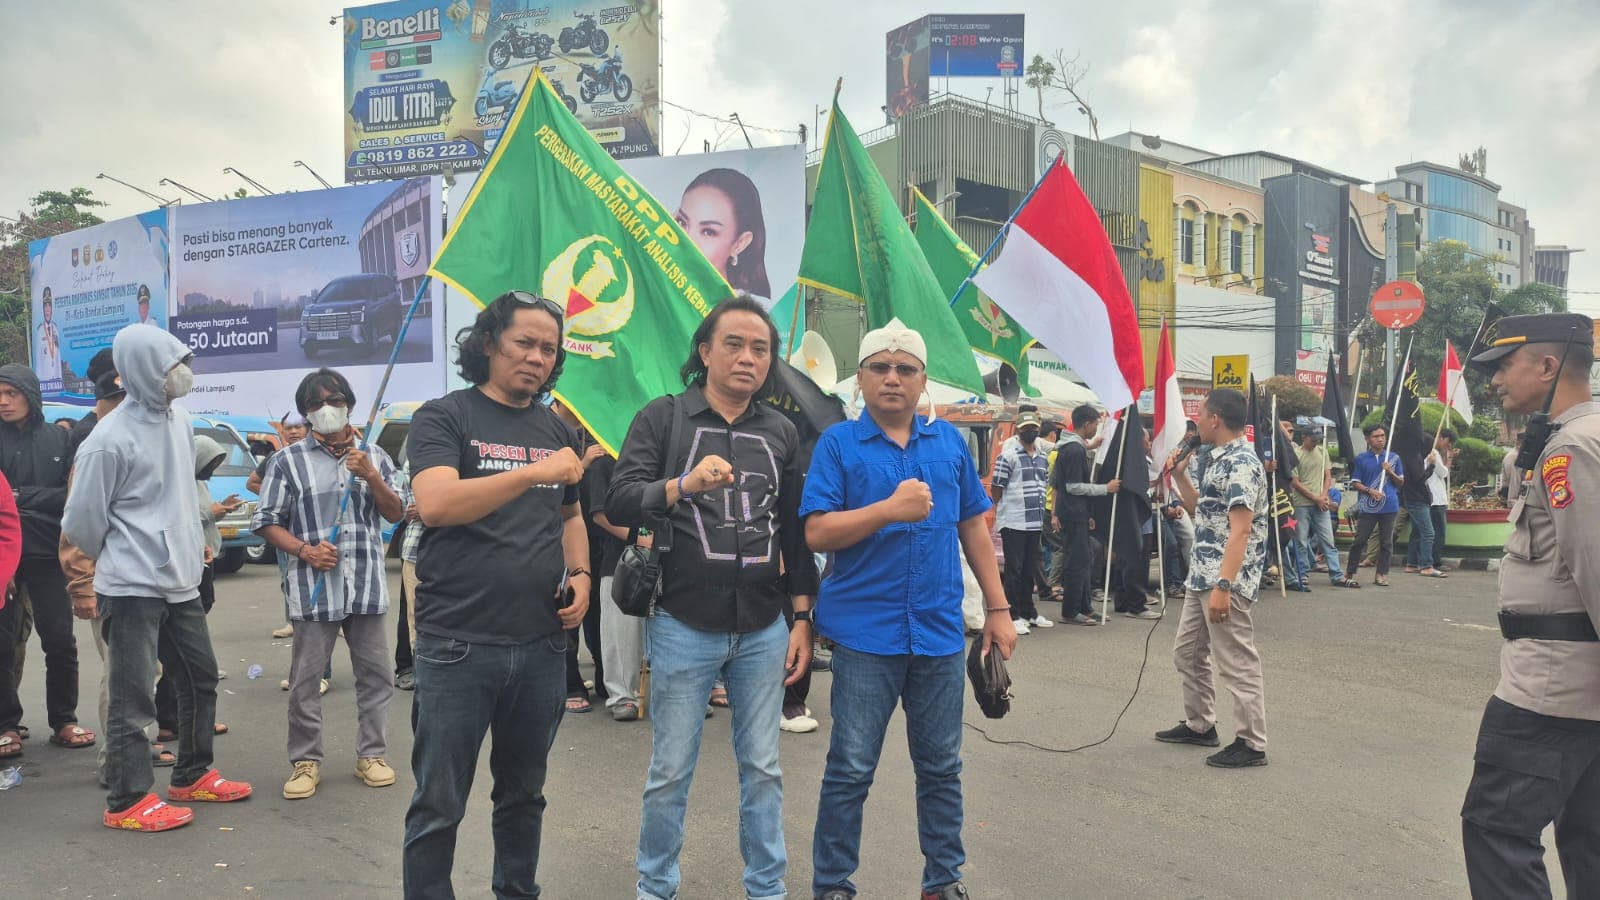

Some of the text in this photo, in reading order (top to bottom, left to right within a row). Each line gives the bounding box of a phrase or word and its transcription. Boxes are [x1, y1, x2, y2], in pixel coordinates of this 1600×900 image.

[361, 7, 441, 41] Benelli
[368, 82, 435, 97] SELAMAT HARI RAYA
[368, 90, 435, 124] IDUL FITRI
[360, 133, 445, 148] SALES & SERVICE
[368, 143, 468, 162] 0819 862 222
[534, 124, 592, 180] PERGERAKAN
[584, 172, 650, 243] MASYARAKAT
[642, 239, 688, 290] ANALISIS
[613, 175, 680, 246] DPP
[183, 217, 333, 246] Pasti bisa menang banyak
[183, 234, 350, 262] dengan STARGAZER Cartenz.
[177, 315, 249, 330] Potongan harga s.d.
[189, 331, 209, 349] 50
[1217, 372, 1242, 385] Lois
[206, 384, 235, 394] Lampung
